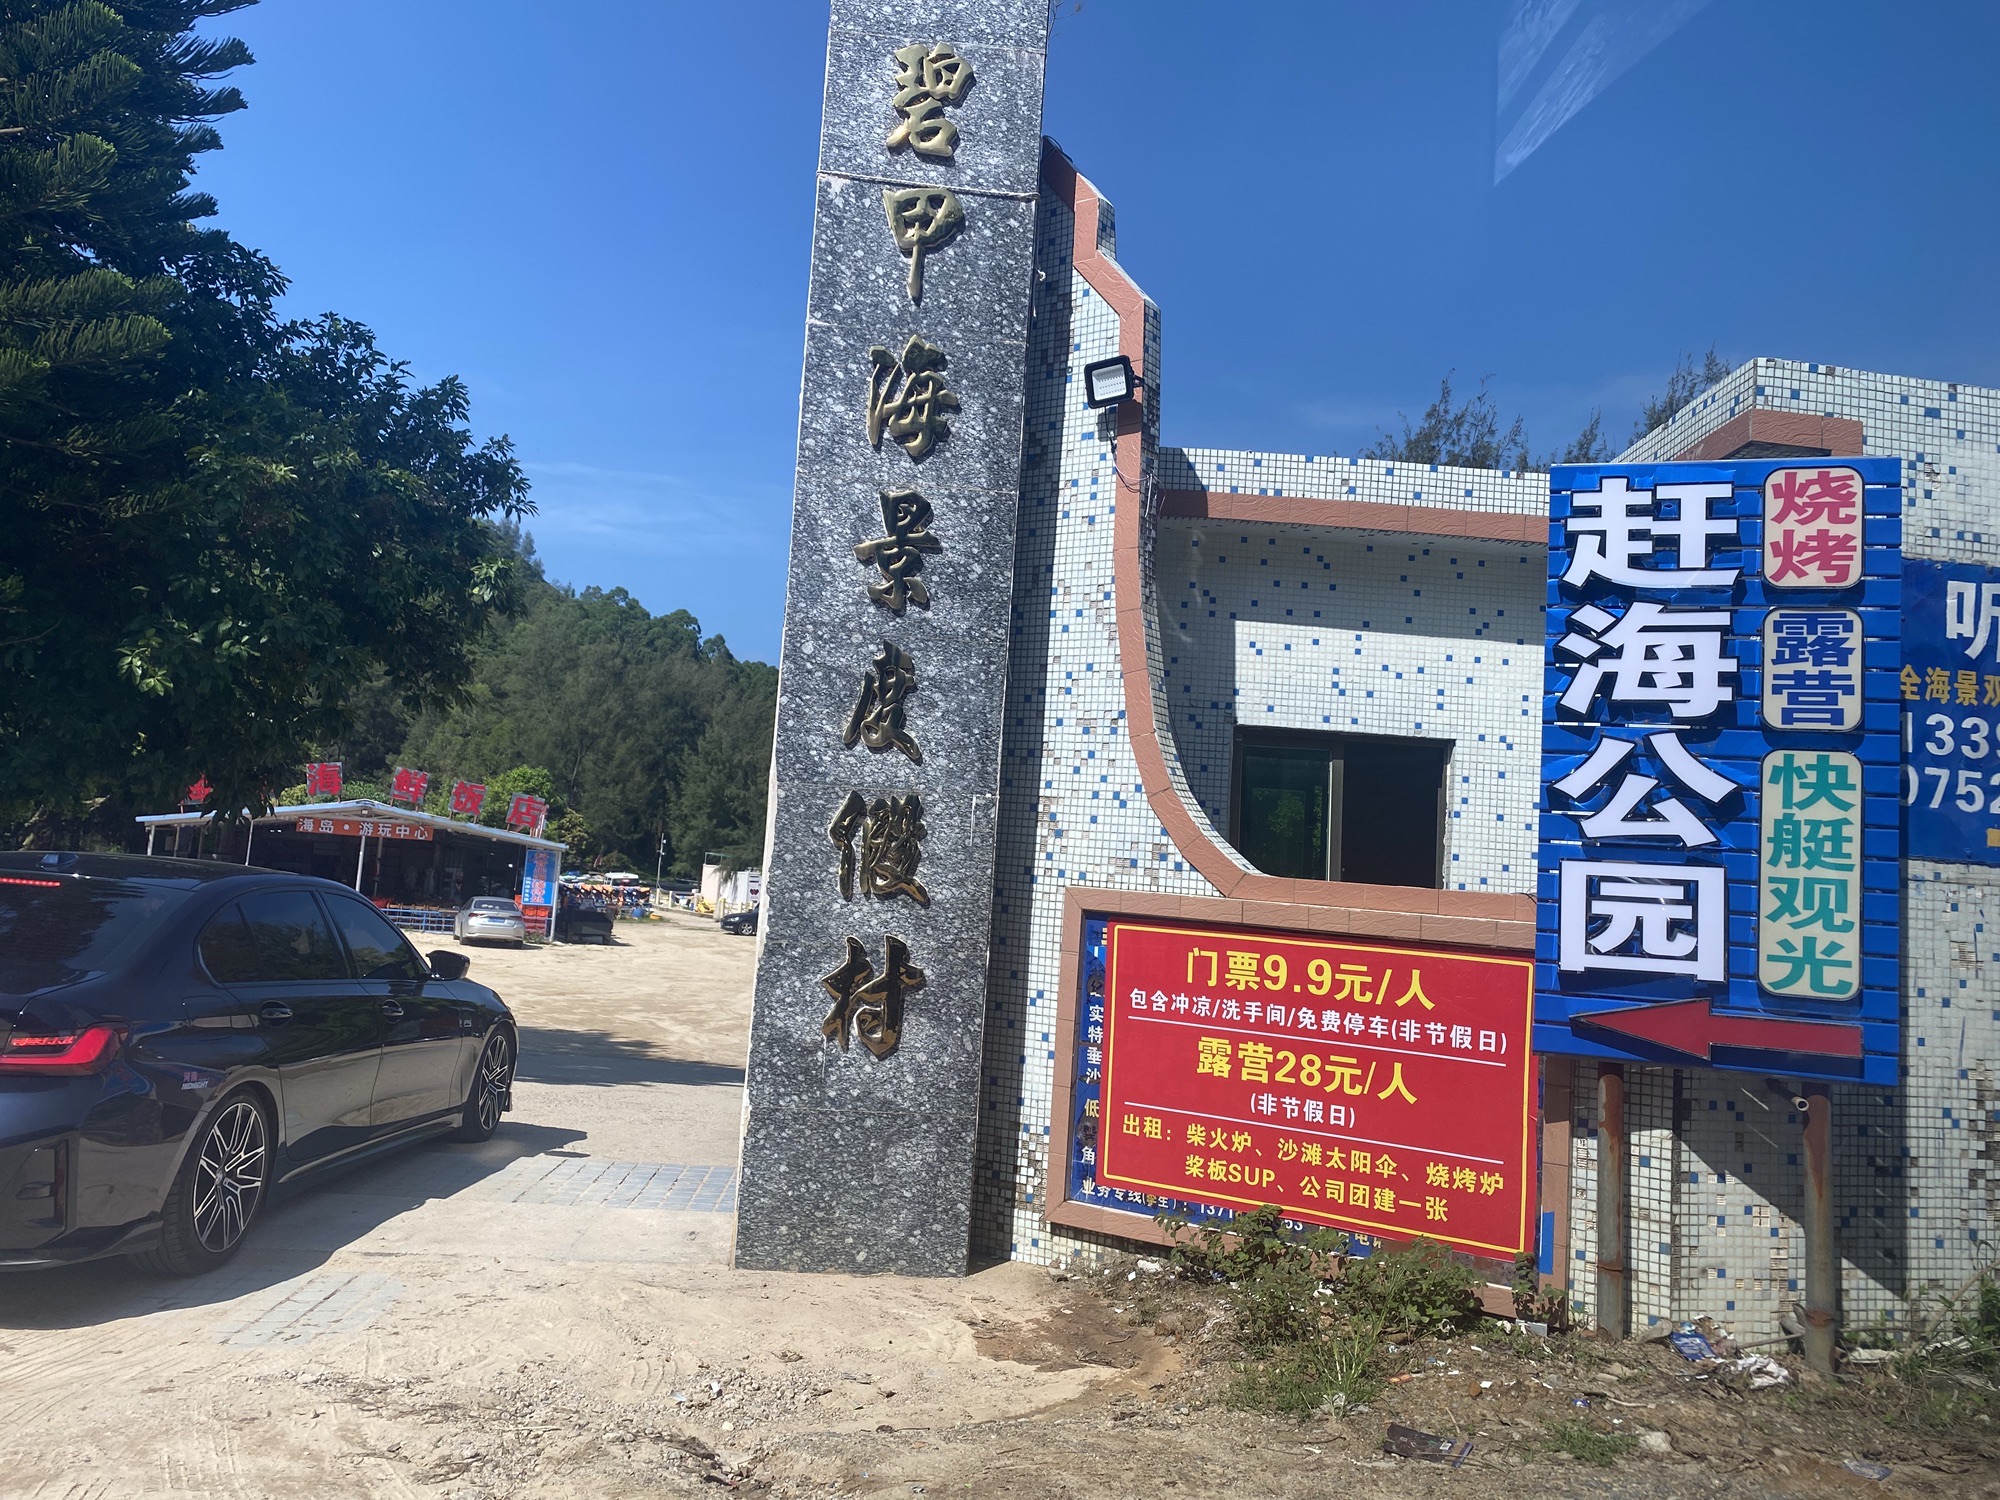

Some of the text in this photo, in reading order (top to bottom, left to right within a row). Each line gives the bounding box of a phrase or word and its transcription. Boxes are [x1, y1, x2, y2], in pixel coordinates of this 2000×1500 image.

[1769, 471, 1859, 584] 烧烤
[1770, 610, 1857, 727] 露营
[1552, 476, 1741, 983] 赶海公园
[1901, 712, 2000, 760] 133
[306, 763, 546, 828] 海鲜饭店
[1766, 753, 1857, 995] 快艇观光
[1187, 947, 1436, 1011] 门票9.9元/人
[1129, 987, 1507, 1055] 包含冲凉/洗手间/免费停车(非节假日)
[1196, 1036, 1418, 1105] 露营28元/人
[1250, 1093, 1356, 1128] (非节假日)
[1184, 1154, 1449, 1222] 桨板SUP、公司团建一张
